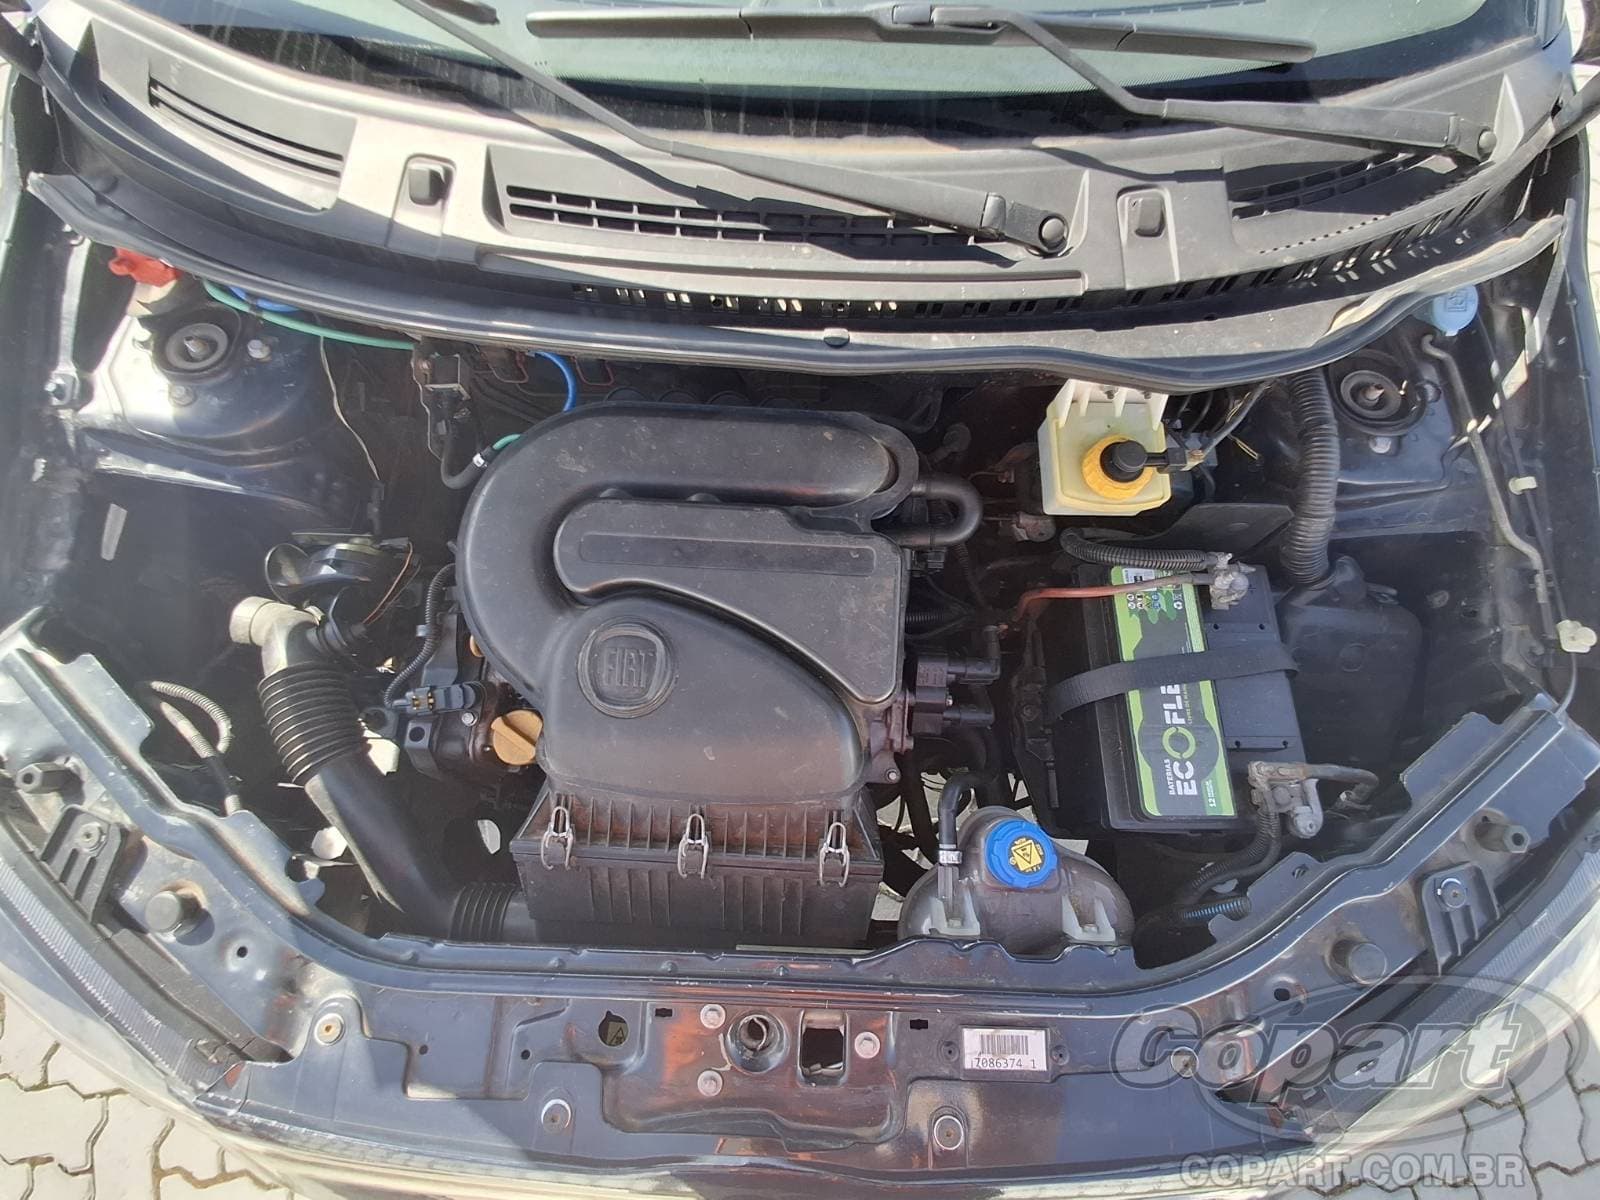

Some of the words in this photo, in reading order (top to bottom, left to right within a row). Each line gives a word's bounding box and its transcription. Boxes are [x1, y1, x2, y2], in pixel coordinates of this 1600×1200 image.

[602, 648, 656, 688] FIAT
[1160, 684, 1198, 796] ECOFLE
[1164, 759, 1176, 796] BATERIAS
